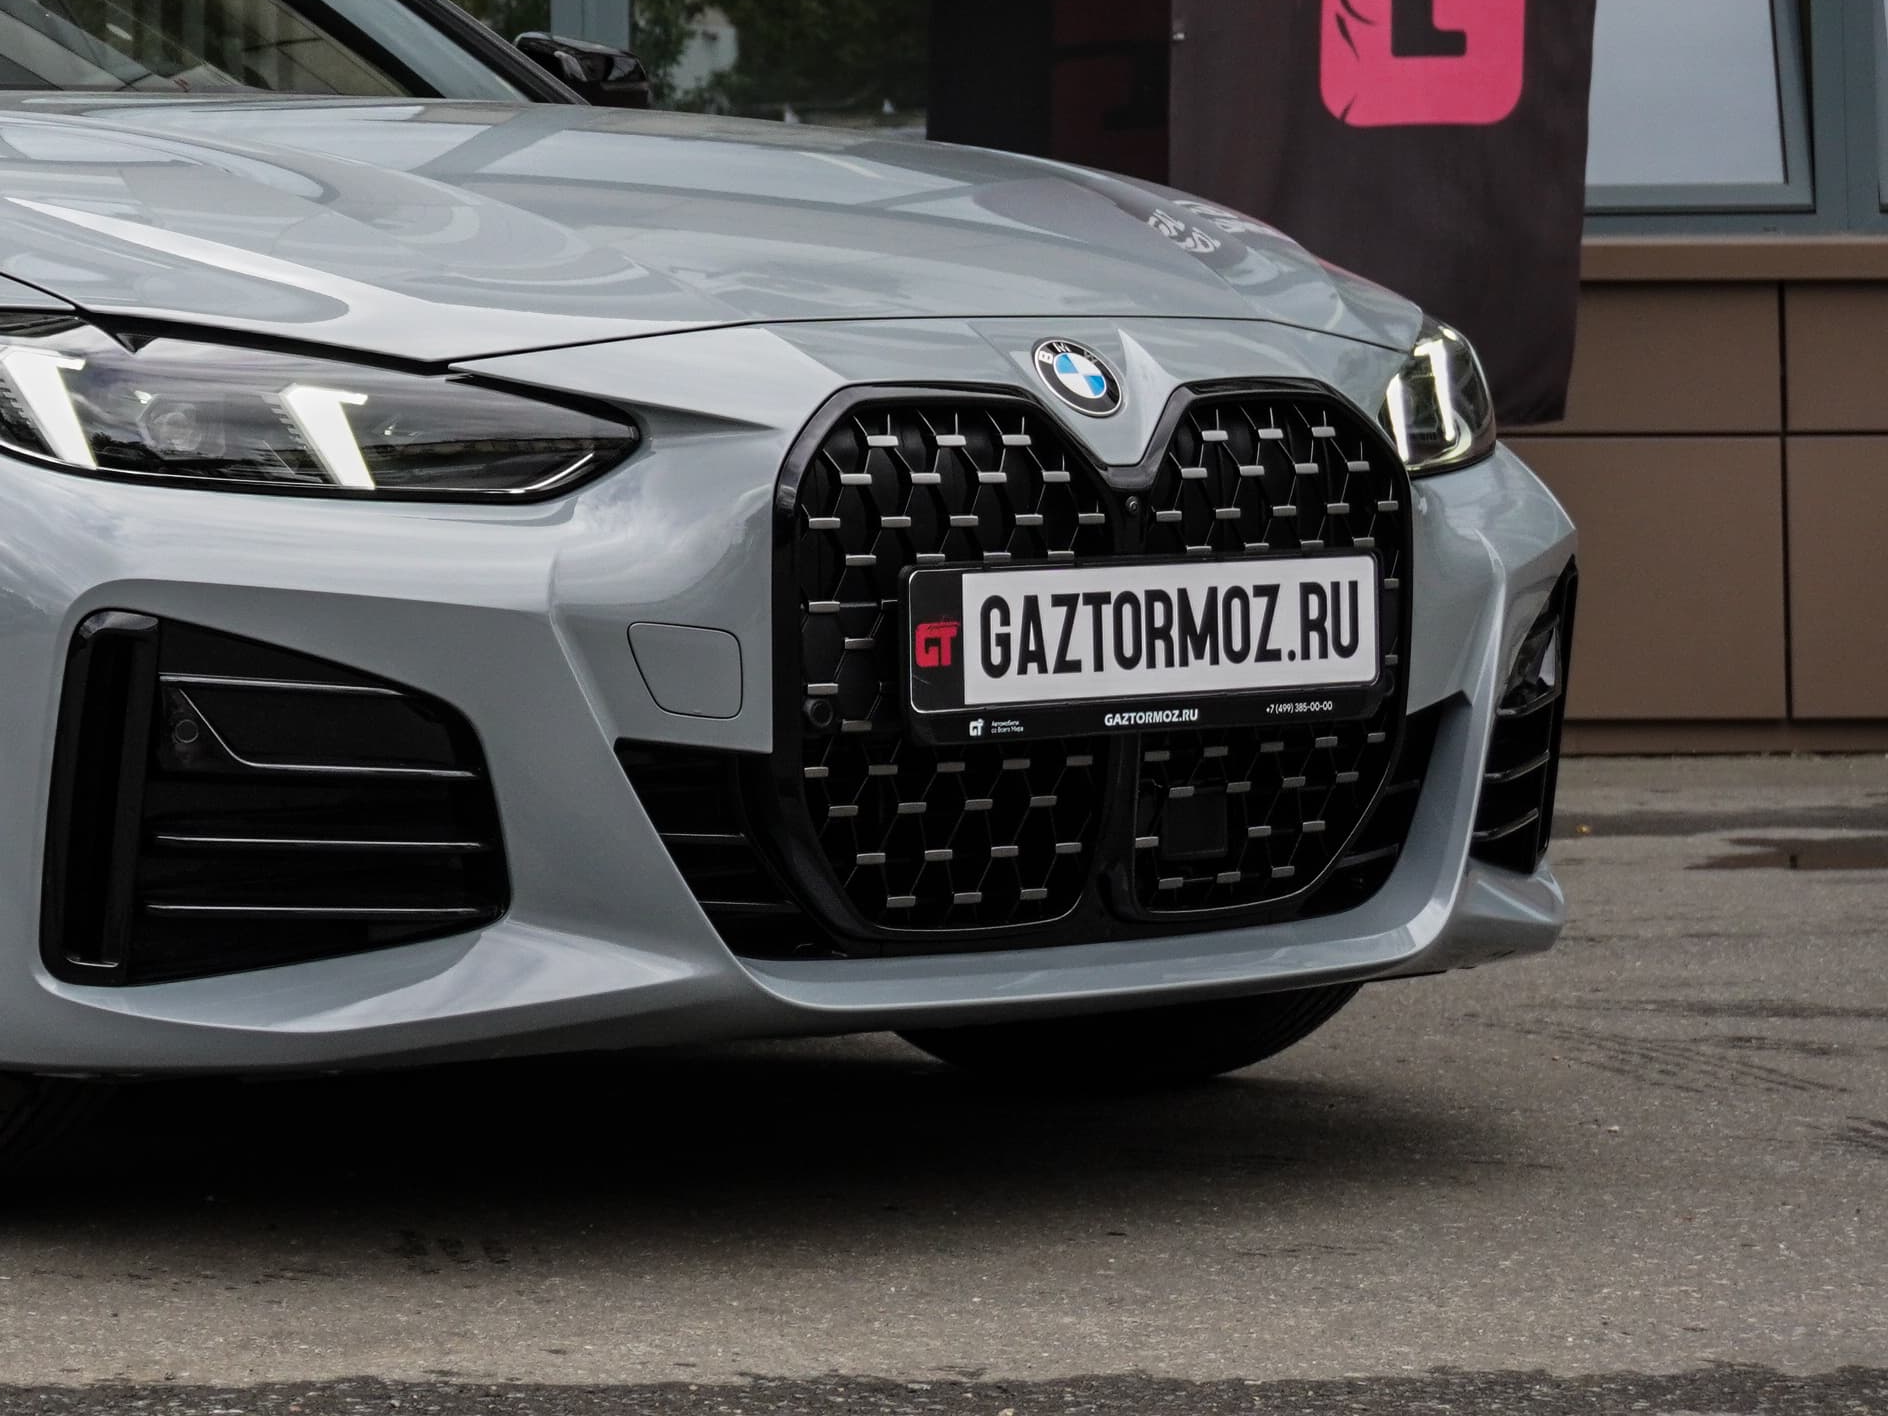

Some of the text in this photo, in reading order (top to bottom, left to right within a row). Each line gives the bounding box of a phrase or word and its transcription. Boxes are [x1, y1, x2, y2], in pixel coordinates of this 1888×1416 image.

[915, 580, 1360, 679] GT GAZTORMOZ.RU
[1275, 703, 1294, 714] (499)
[1295, 700, 1333, 712] 385-00-00
[1104, 708, 1199, 726] GAZTORMOZ.RU
